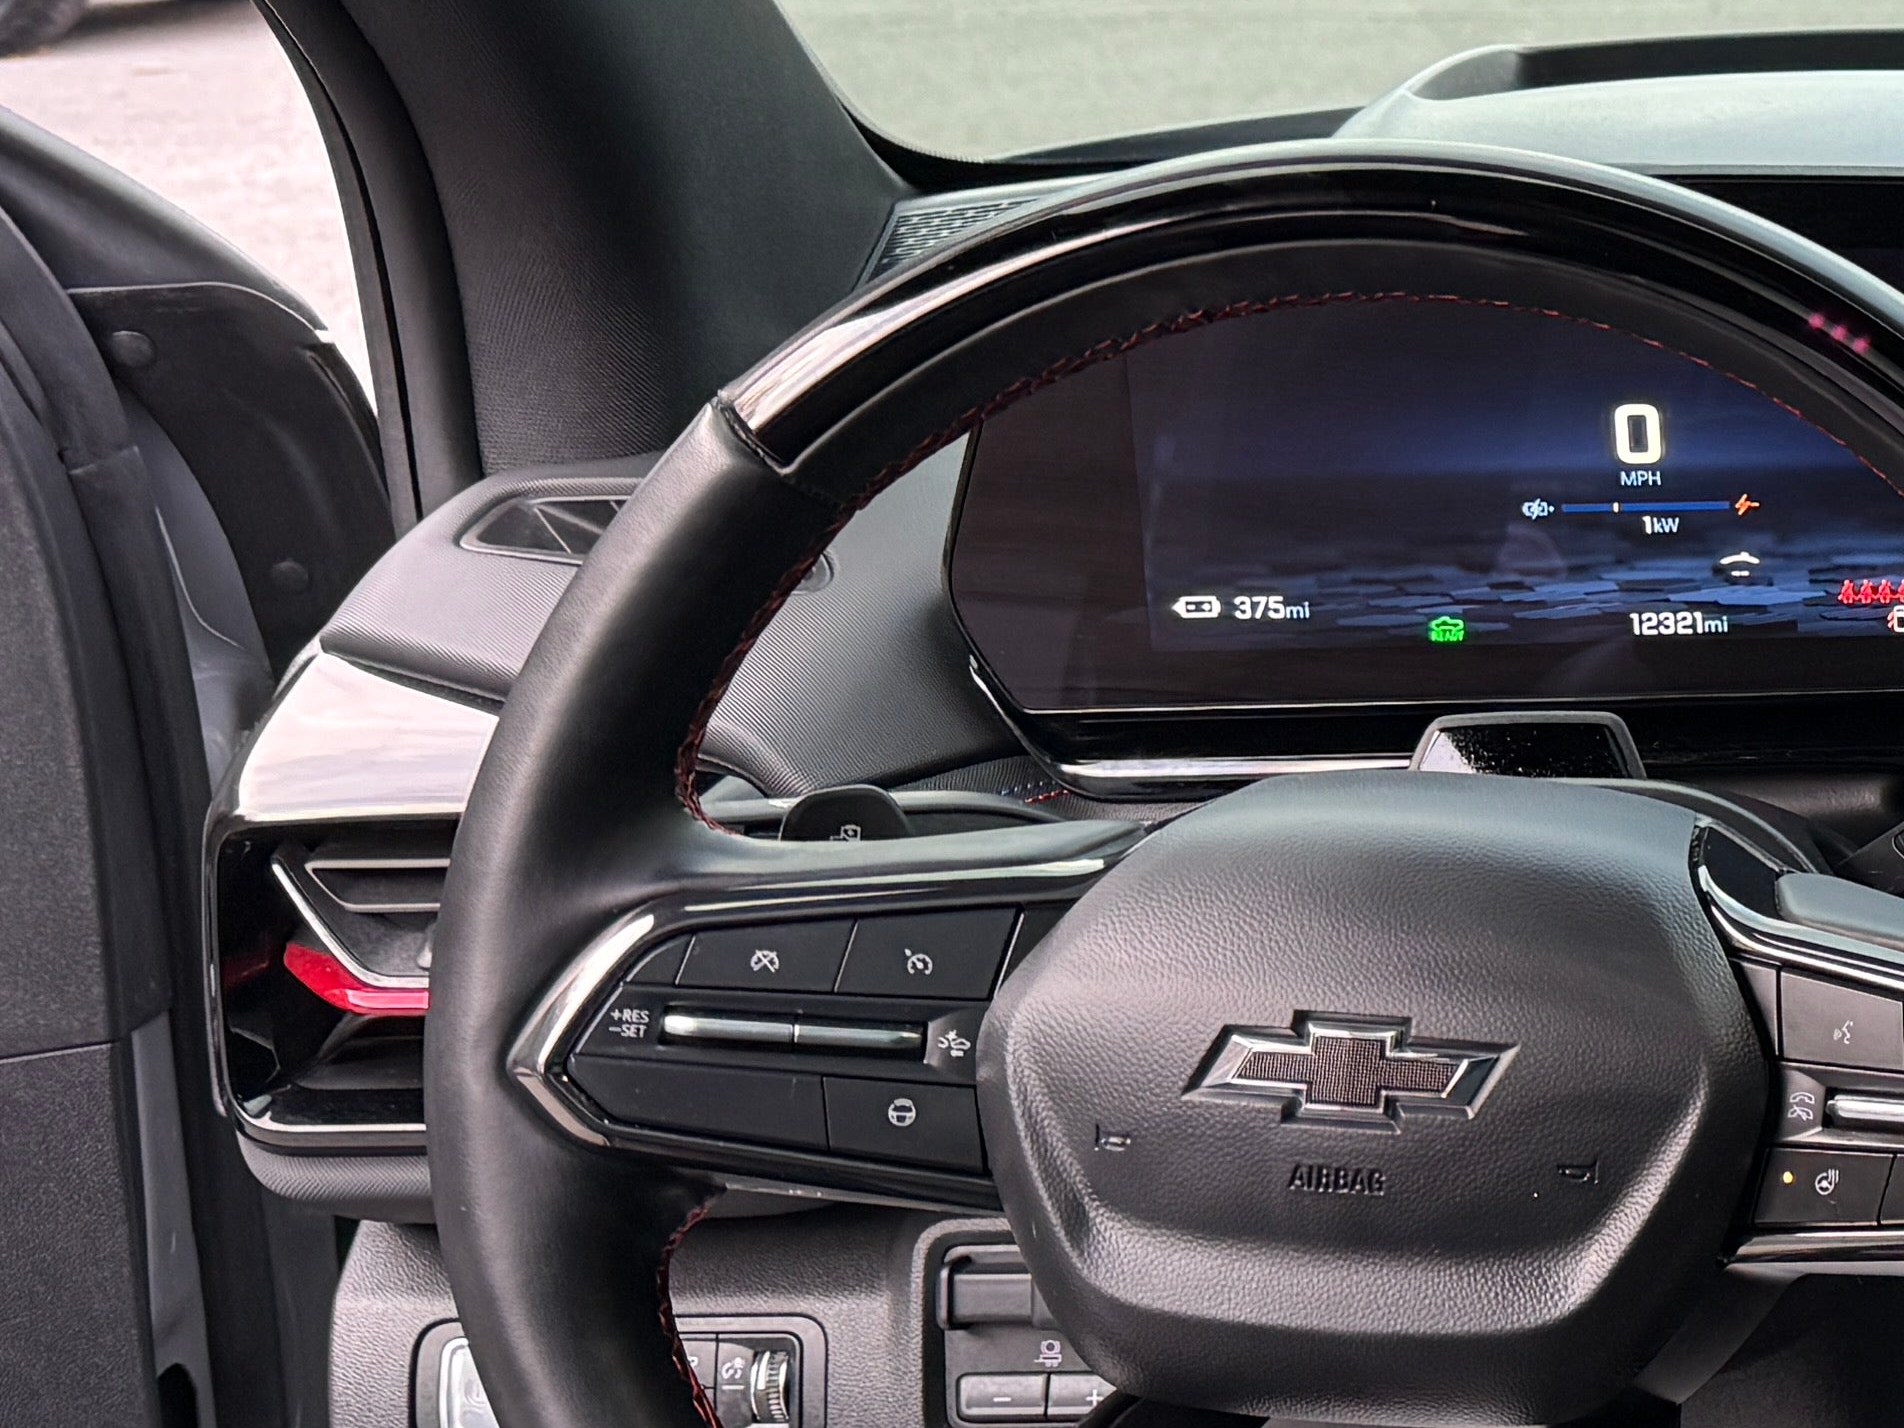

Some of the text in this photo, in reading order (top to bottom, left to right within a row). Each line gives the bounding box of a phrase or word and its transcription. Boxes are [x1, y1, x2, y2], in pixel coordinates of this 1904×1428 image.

[1613, 402, 1663, 466] 0
[1620, 471, 1662, 487] MPH
[1288, 1161, 1388, 1198] AIRBAG
